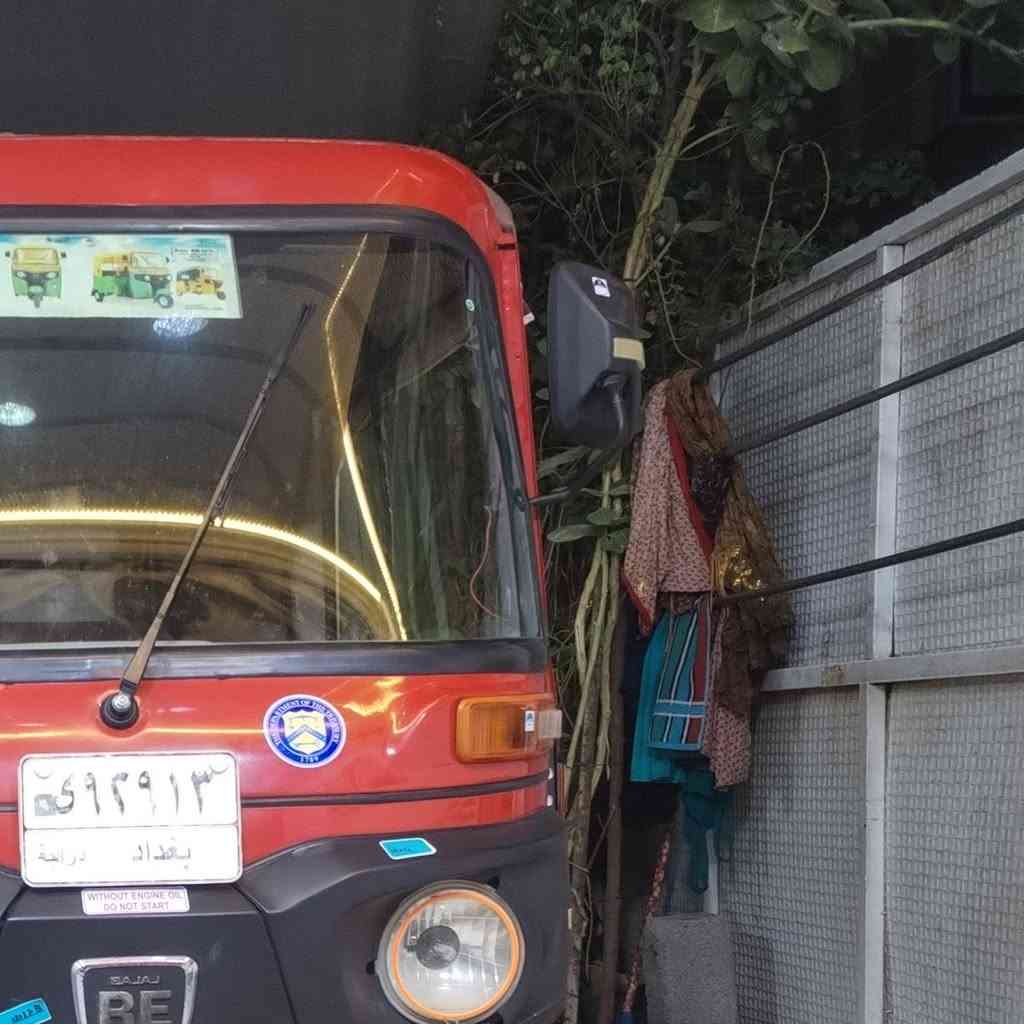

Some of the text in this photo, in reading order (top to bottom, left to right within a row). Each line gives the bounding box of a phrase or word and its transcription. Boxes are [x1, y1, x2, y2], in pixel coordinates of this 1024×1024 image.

[87, 891, 183, 901] WITHOUT ENGINE OIL
[103, 902, 169, 911] DO NOT START
[109, 975, 161, 985] BAJAJ
